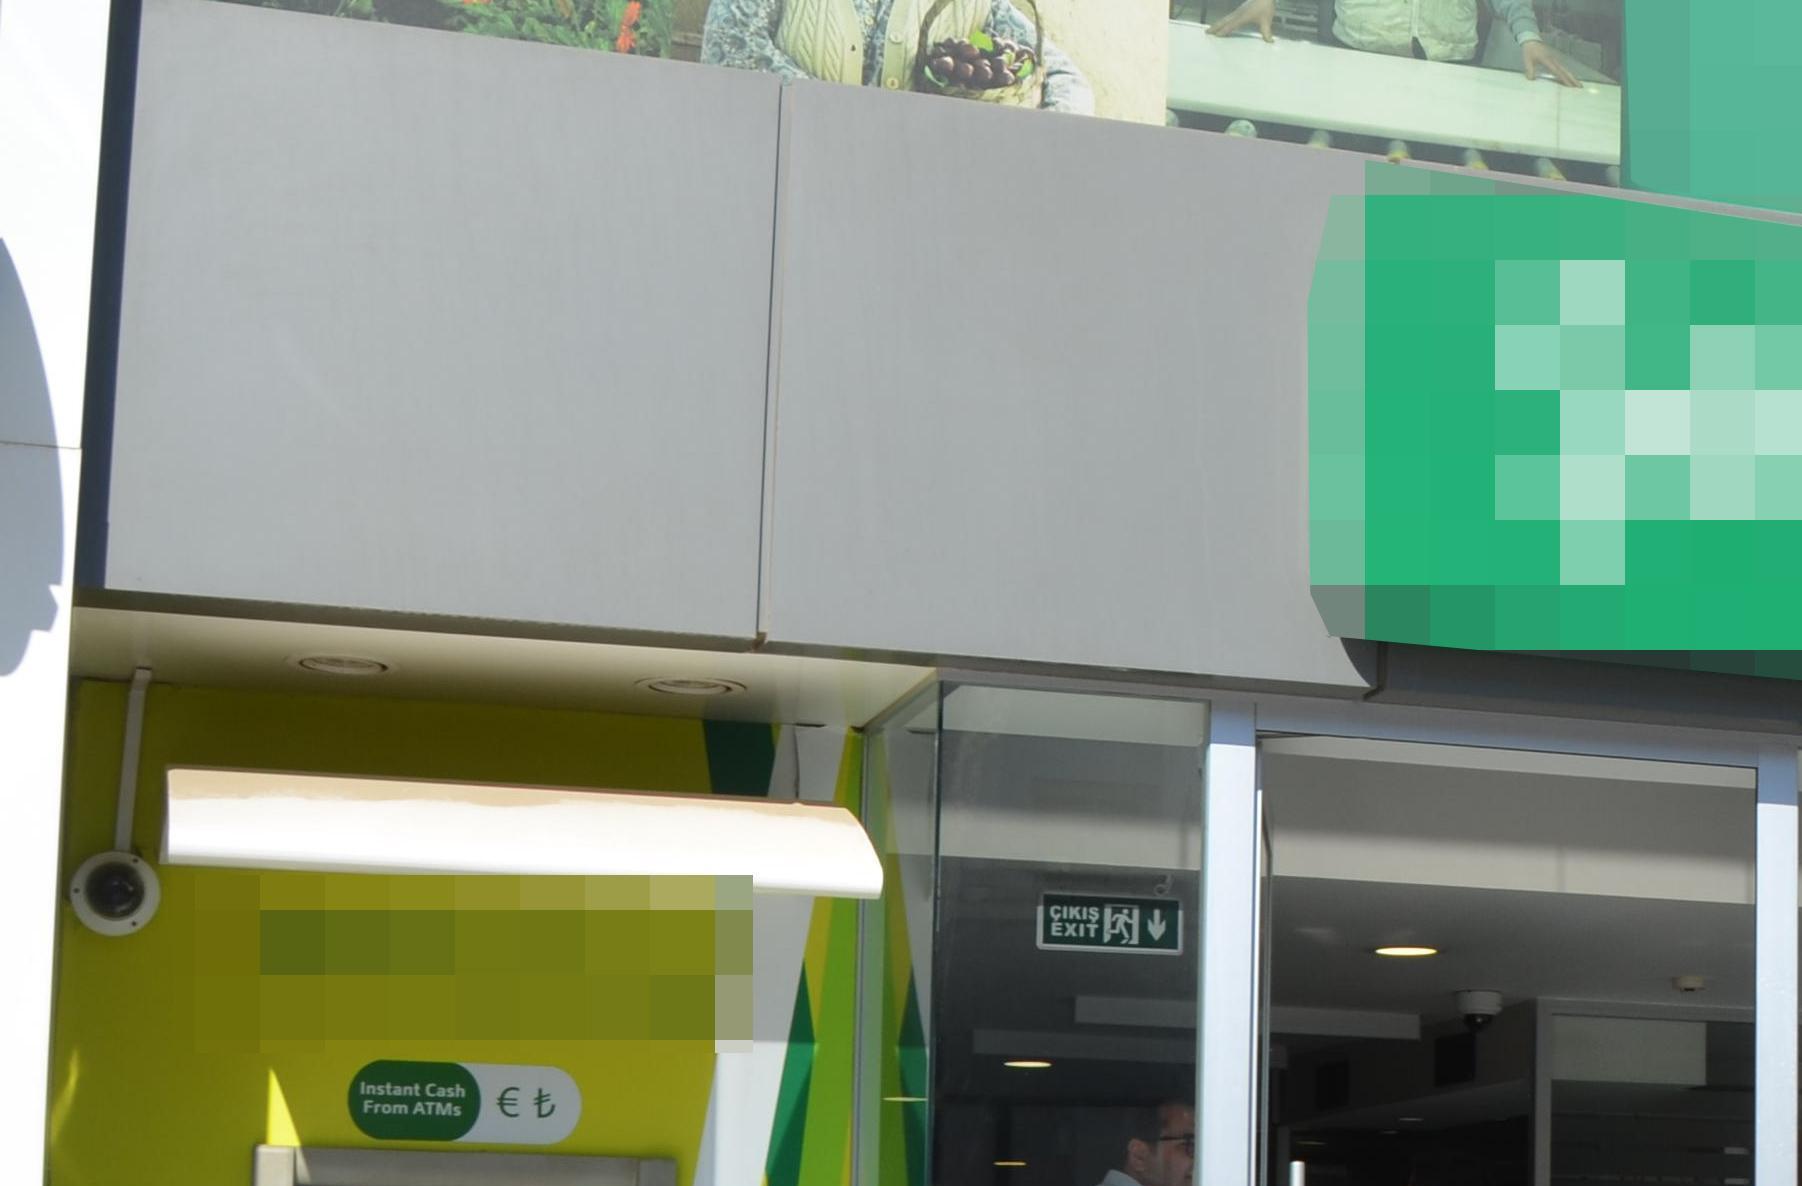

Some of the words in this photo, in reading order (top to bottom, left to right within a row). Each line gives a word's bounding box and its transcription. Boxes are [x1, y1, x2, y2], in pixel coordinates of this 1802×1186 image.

[1050, 905, 1099, 922] ÇIKIŞ
[1051, 922, 1098, 938] EXIT
[360, 1081, 421, 1097] Instant
[425, 1083, 466, 1098] Cash
[363, 1100, 408, 1114] From
[412, 1101, 462, 1117] ATMs
